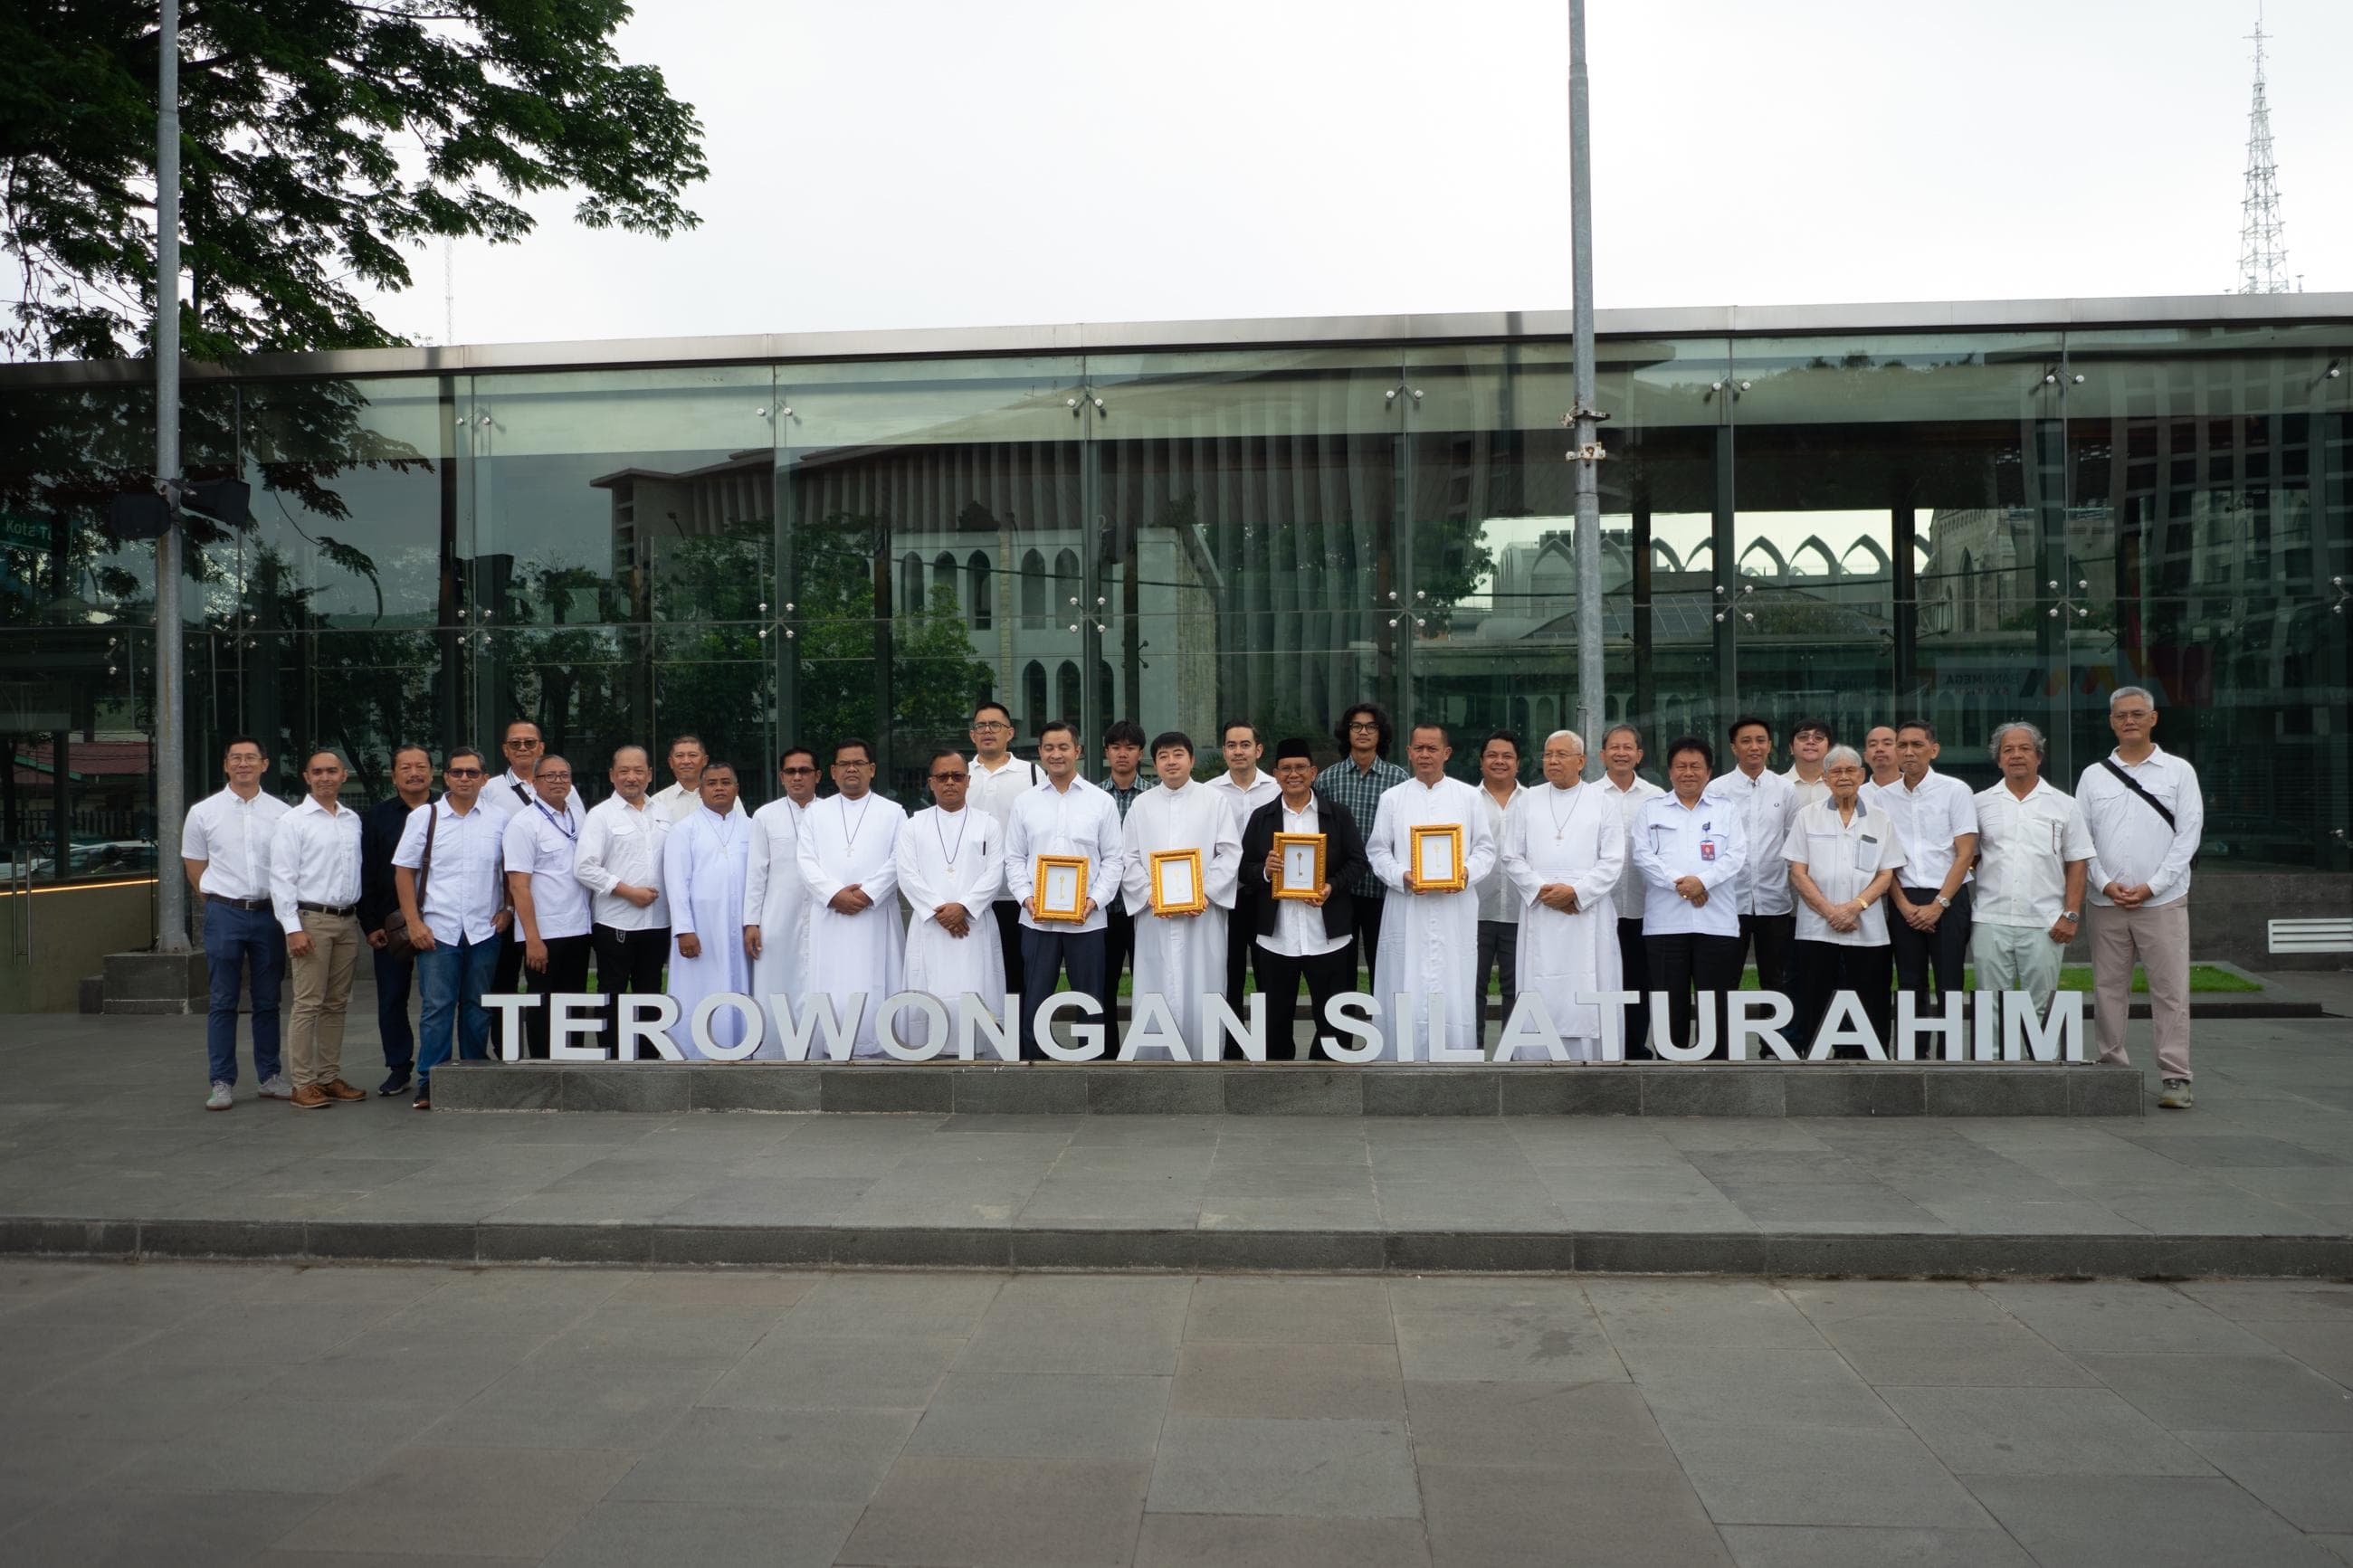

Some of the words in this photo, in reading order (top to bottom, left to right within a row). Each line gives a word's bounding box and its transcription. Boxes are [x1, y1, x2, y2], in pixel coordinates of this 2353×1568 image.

[6, 519, 36, 537] Kota
[481, 992, 1267, 1062] TEROWONGAN
[1320, 990, 2083, 1062] SILATURAHIM
